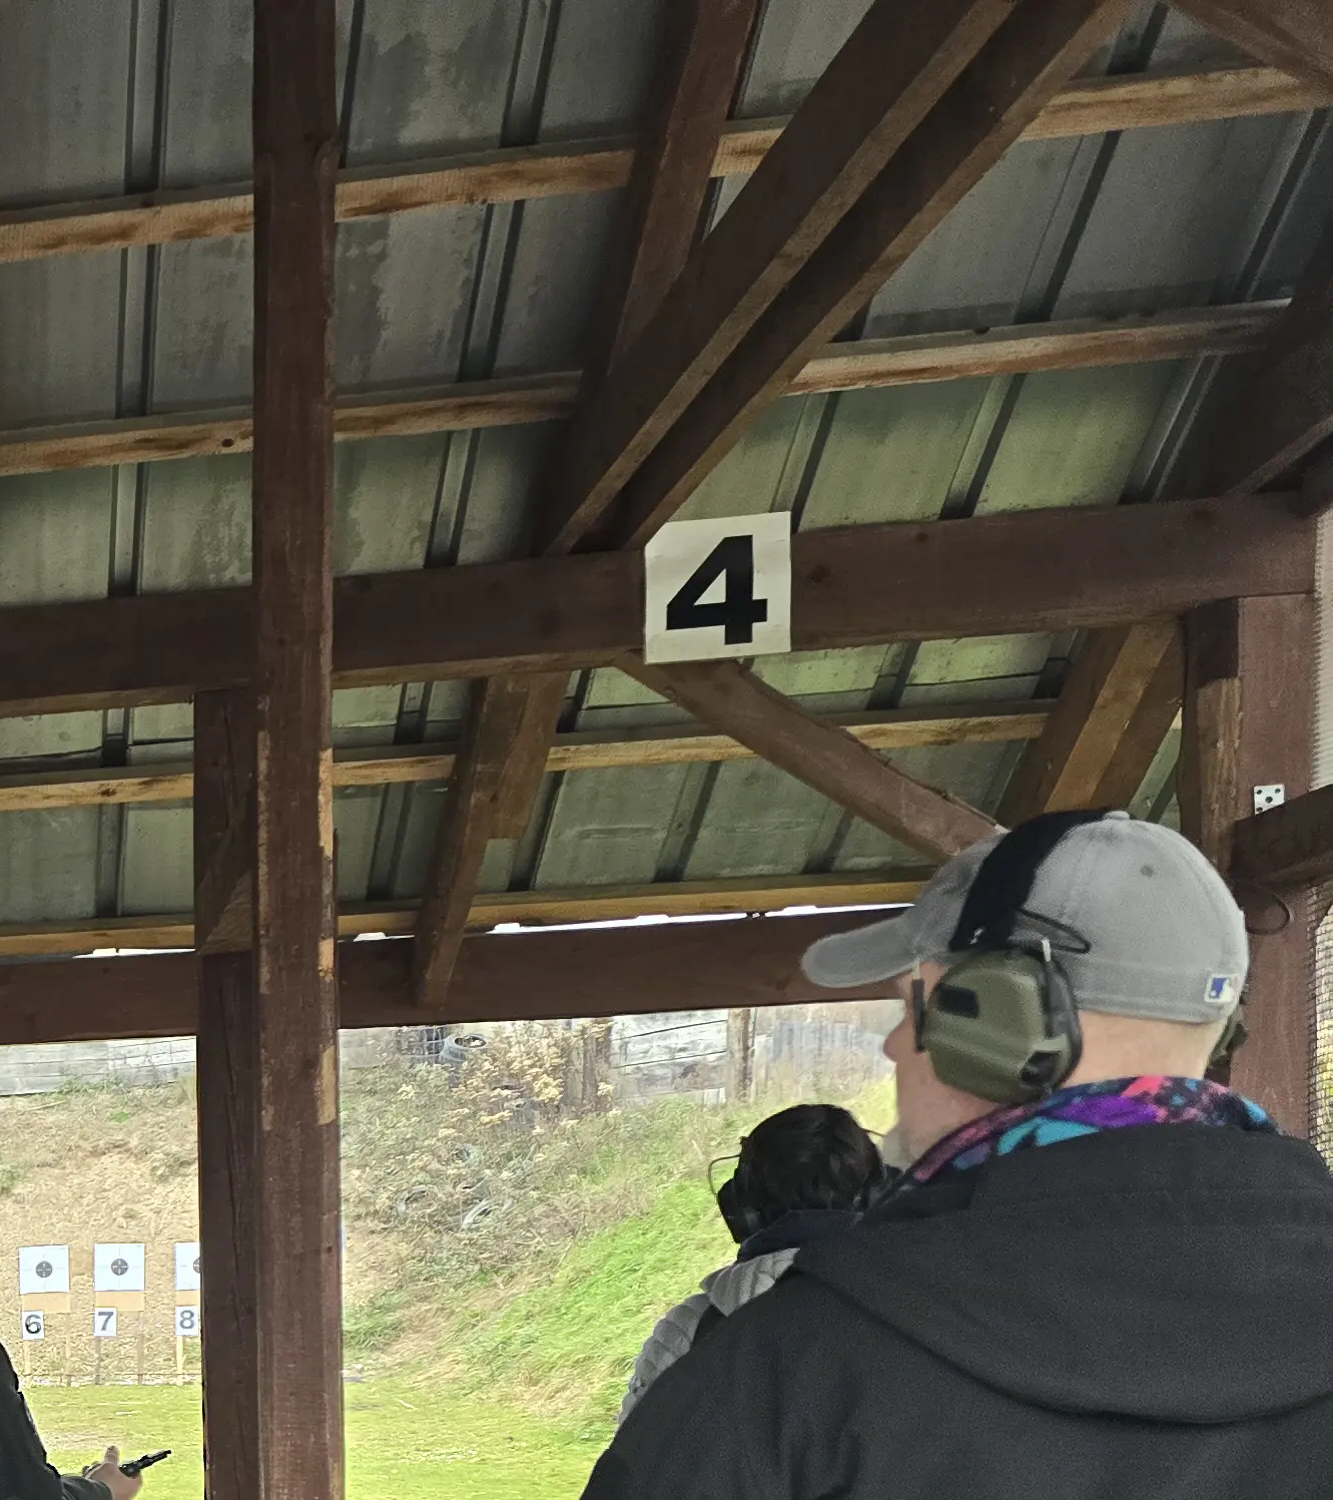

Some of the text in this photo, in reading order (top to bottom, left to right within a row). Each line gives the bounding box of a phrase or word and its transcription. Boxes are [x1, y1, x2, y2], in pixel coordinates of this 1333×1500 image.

[666, 534, 768, 645] 4
[25, 1314, 42, 1334] 6
[98, 1311, 114, 1331] 7
[179, 1309, 195, 1329] 8
